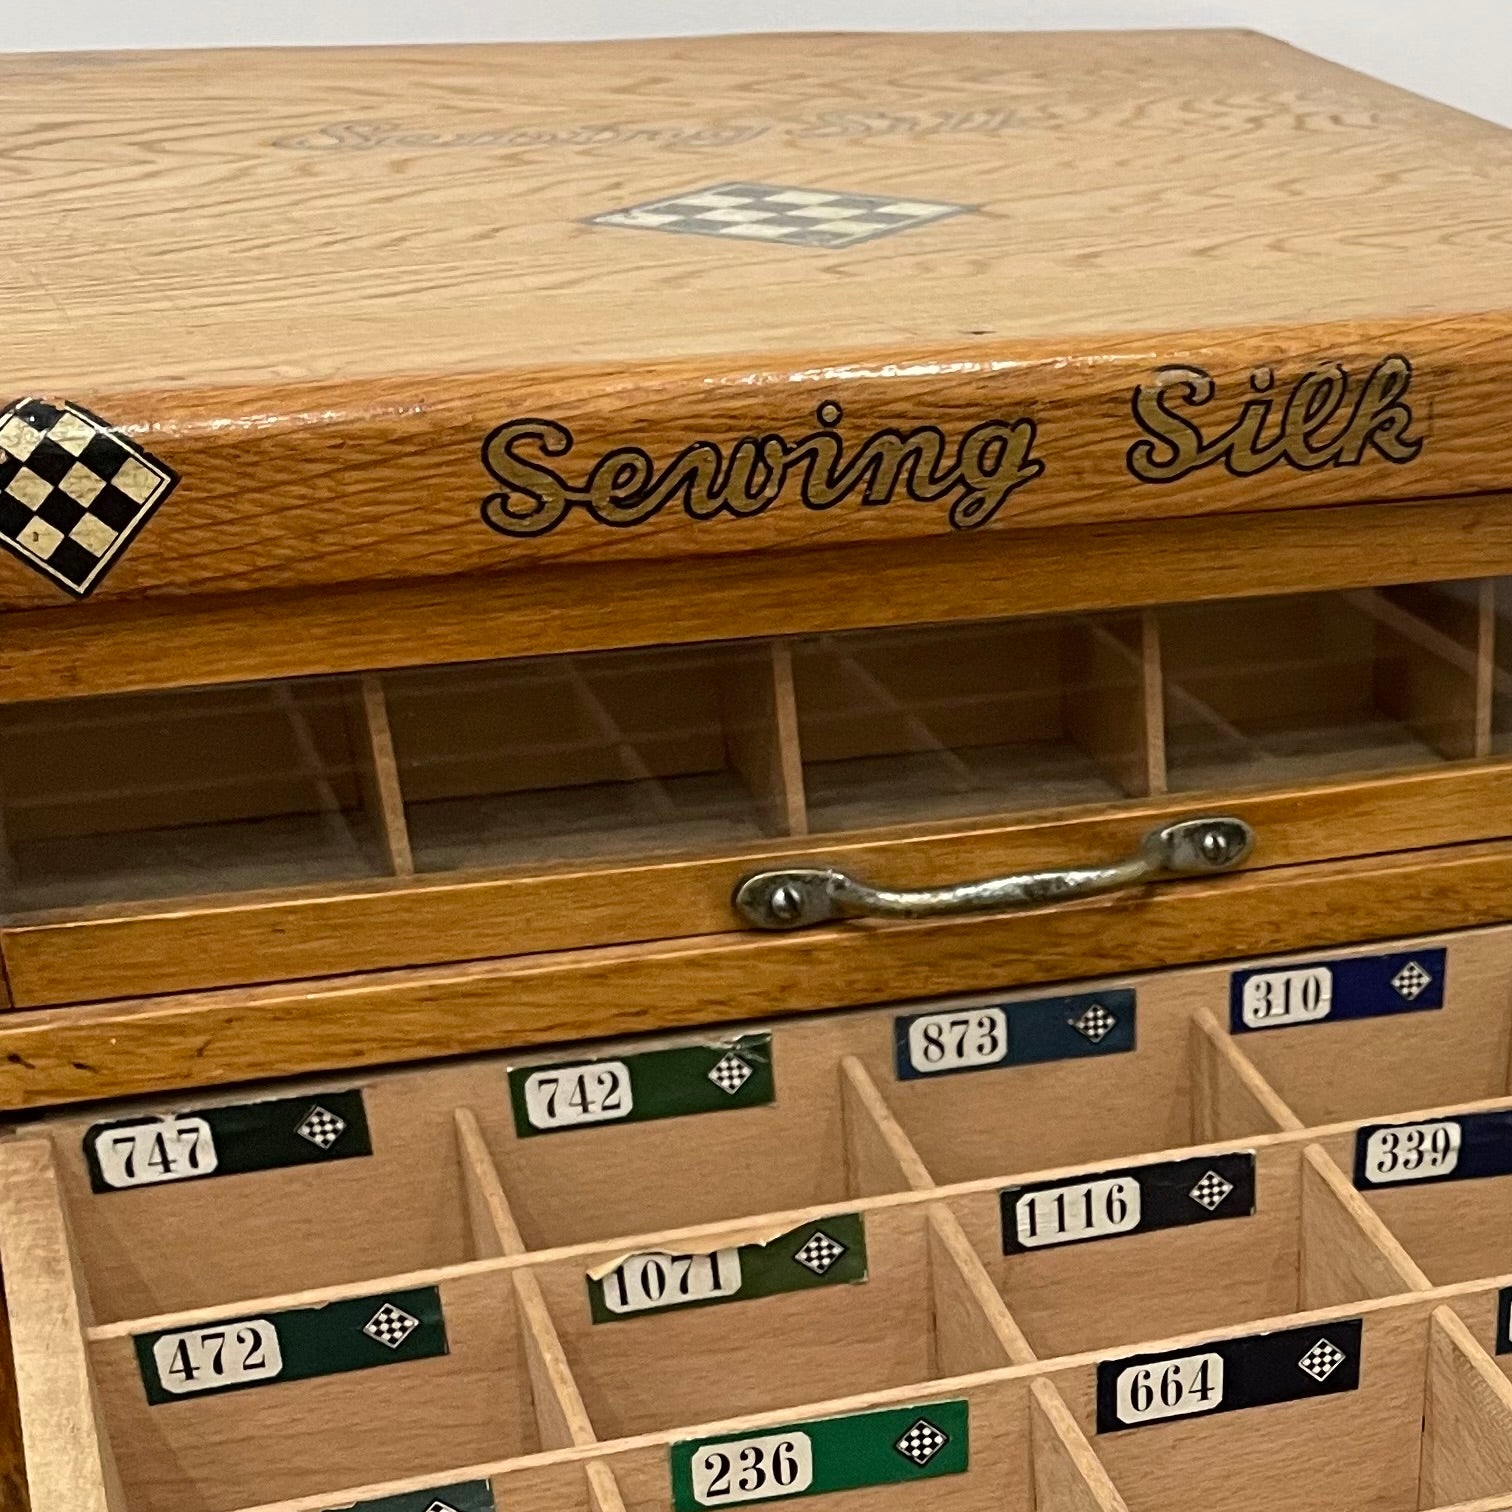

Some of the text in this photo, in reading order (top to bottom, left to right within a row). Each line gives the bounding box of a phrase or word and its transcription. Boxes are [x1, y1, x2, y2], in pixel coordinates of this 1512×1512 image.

[480, 353, 1424, 538] Sewing Silk
[1251, 974, 1323, 1018] 310
[922, 1015, 999, 1062] 873
[537, 1070, 621, 1119] 742
[112, 1126, 203, 1179] 747
[1377, 1127, 1451, 1173] 339
[1021, 1184, 1129, 1238] 1116
[613, 1250, 723, 1306] 1071
[168, 1327, 266, 1382] 472
[1130, 1359, 1215, 1412] 664
[704, 1441, 799, 1498] 236
